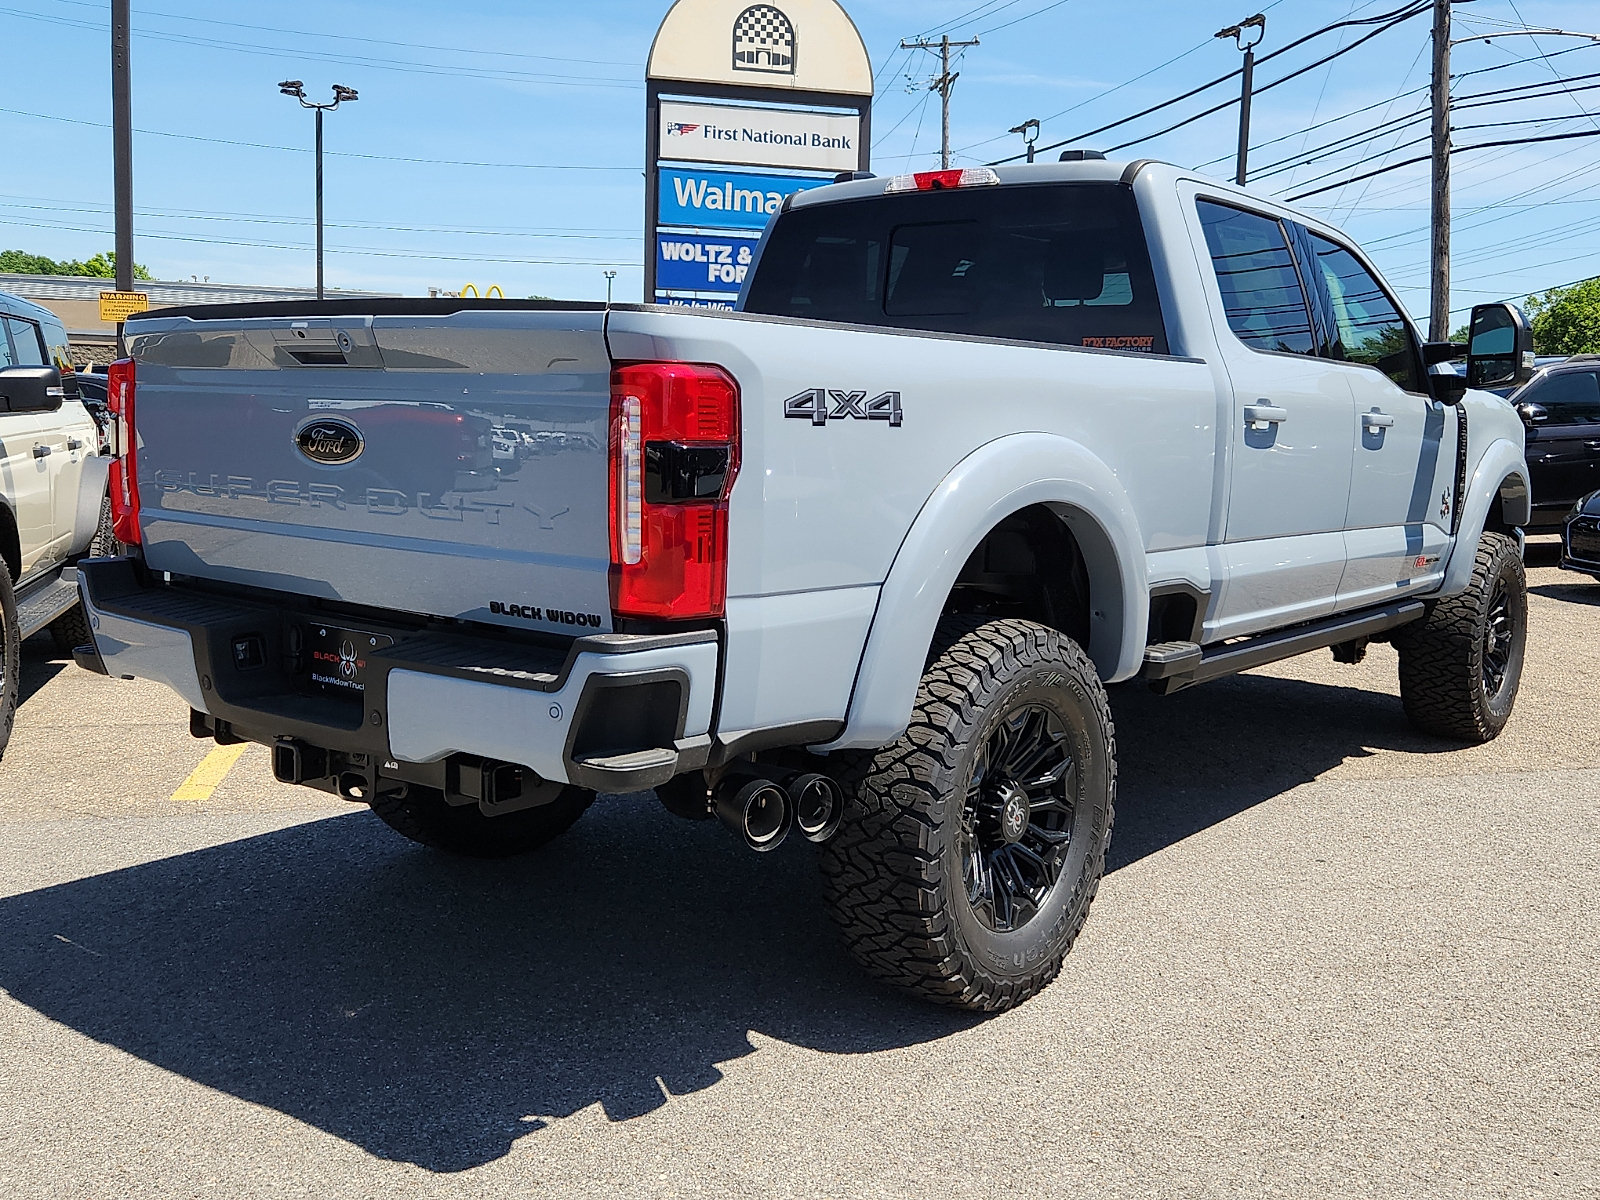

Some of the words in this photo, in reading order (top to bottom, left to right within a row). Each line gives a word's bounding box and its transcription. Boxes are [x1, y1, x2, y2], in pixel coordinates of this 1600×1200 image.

[703, 125, 737, 141] First
[741, 128, 807, 146] National
[811, 133, 852, 150] Bank
[673, 177, 804, 214] Walma
[661, 241, 733, 265] WOLTZ
[736, 246, 753, 266] &
[1082, 337, 1105, 348] FOX
[1105, 336, 1154, 347] FACTORY
[308, 427, 344, 454] Ford
[154, 468, 347, 512] SUPER
[365, 487, 570, 530] DUTY
[489, 600, 543, 620] BLACK
[545, 608, 602, 628] WIDOW
[313, 651, 340, 663] BLACK
